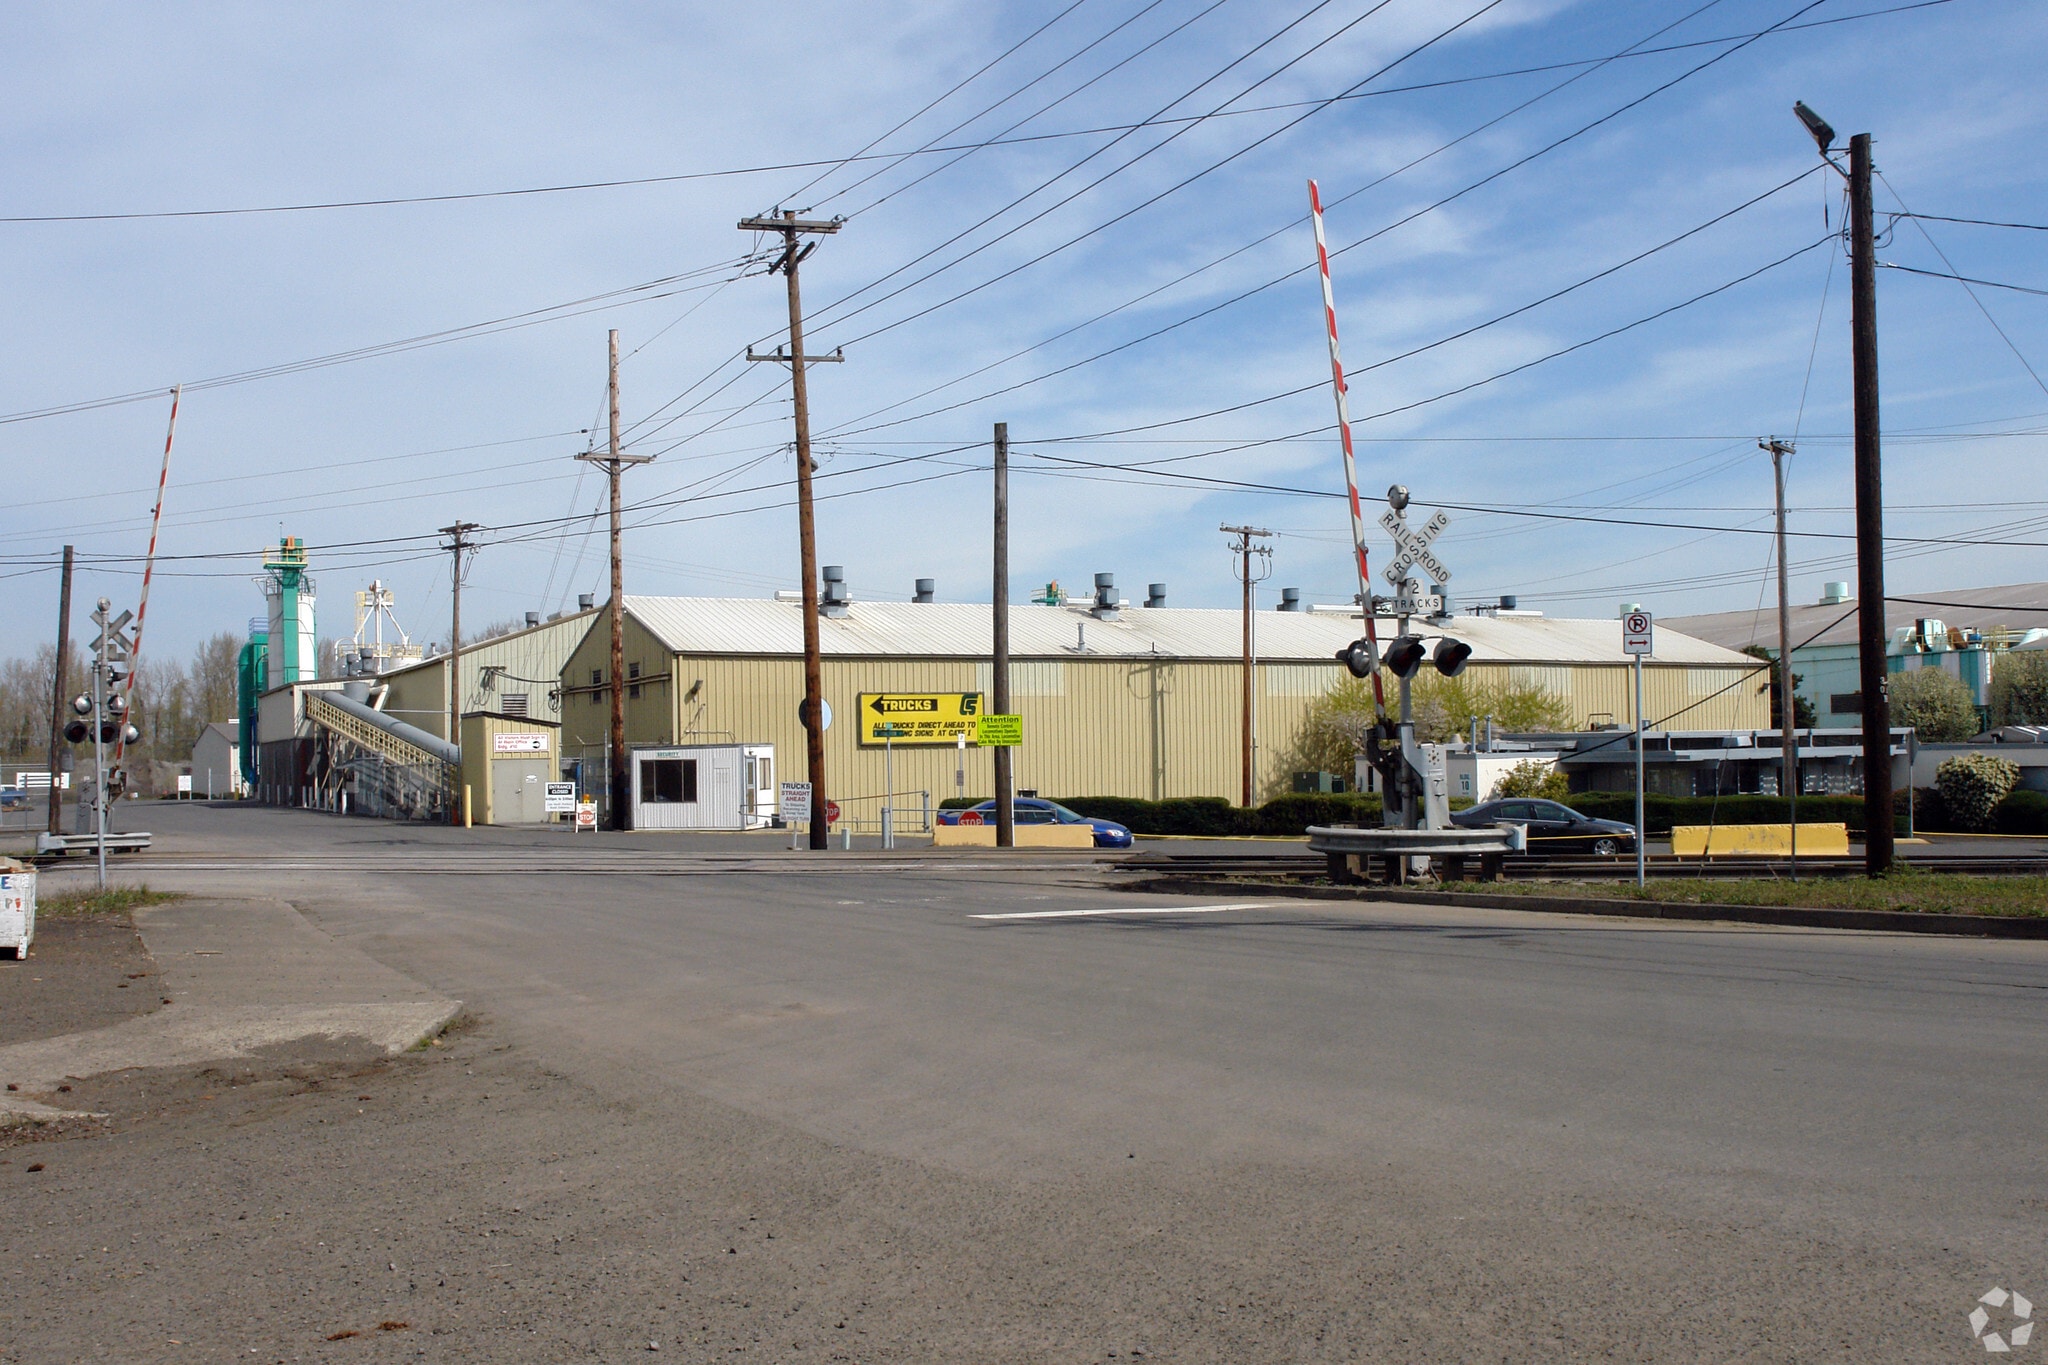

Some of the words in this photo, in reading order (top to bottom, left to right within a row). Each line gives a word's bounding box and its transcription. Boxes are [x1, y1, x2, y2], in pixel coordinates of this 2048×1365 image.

[1383, 513, 1411, 546] RAIL
[1419, 551, 1448, 583] ROAD
[1386, 514, 1447, 582] CROSSING
[1411, 580, 1419, 594] 2
[1394, 598, 1439, 608] TRACKS
[881, 700, 932, 711] TRUCKS
[1461, 781, 1470, 791] 10
